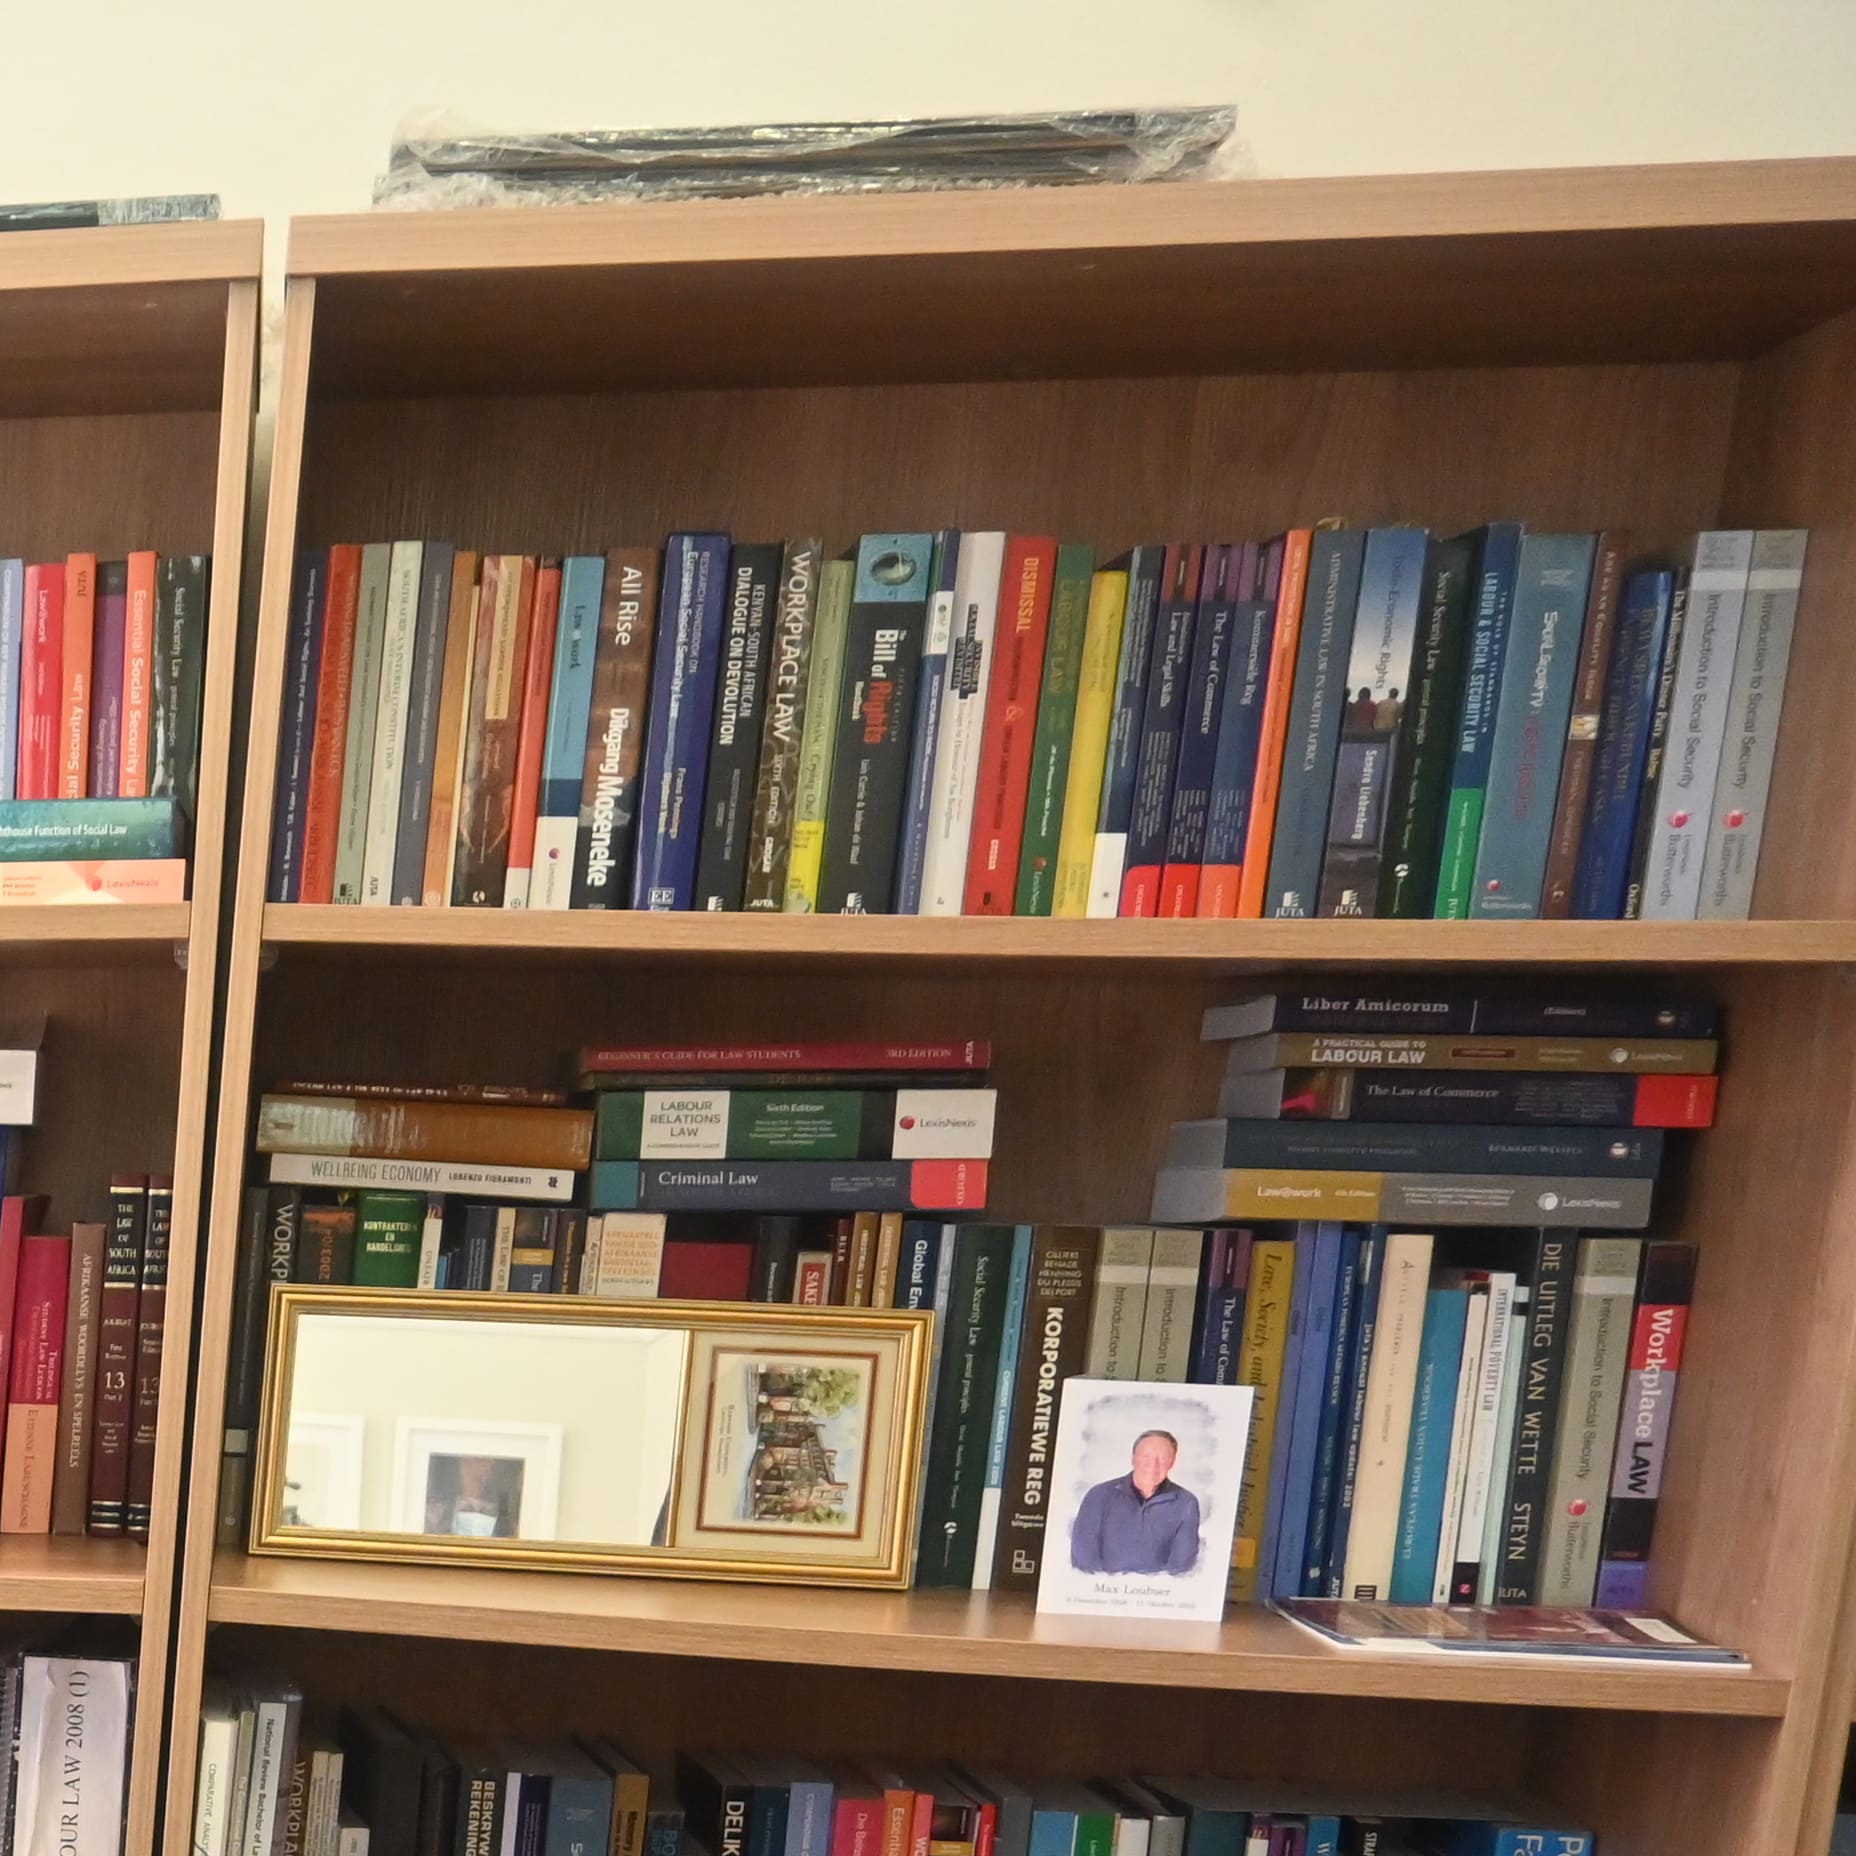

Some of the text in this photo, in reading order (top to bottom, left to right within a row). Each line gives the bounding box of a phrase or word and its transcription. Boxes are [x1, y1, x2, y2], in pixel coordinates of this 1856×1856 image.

[615, 566, 643, 646] All Rise
[776, 551, 811, 688] WORKPLACE
[1015, 557, 1039, 633] DISMISSAL
[126, 590, 146, 774] Essential Social Security
[719, 566, 754, 746] DIALOGUE ON DEVOLUTION
[739, 583, 766, 718] KENYAN-SOUTH AFRICAN
[861, 629, 899, 745] Bill of Rights
[1302, 551, 1342, 772] ADMINISTRATIVE LAW IN SOUTH AFRICA
[1461, 572, 1499, 754] LABOUR & SOCIAL SECURITY LAW
[67, 673, 85, 770] Security Law
[772, 692, 795, 743] LAW
[1677, 592, 1722, 789] Introduction to Social Security
[1733, 592, 1777, 790] Introduction to Social Security
[34, 824, 71, 837] Function
[73, 823, 81, 836] of
[82, 824, 110, 836] Social
[111, 824, 127, 836] Law
[586, 707, 630, 887] Dikgang Moseneke
[767, 786, 780, 825] EDITION
[1351, 749, 1378, 840] Sandra Liebenberg
[1658, 832, 1680, 907] Butterworths
[1713, 832, 1736, 907] Butterworths
[1301, 996, 1450, 1014] Liber Amicorum
[1311, 1048, 1426, 1065] LABOUR LAW
[648, 1112, 722, 1128] RELATIONS
[659, 1098, 715, 1115] LABOUR
[668, 1125, 700, 1140] LAW
[919, 1116, 978, 1131] LexisNexis
[310, 1159, 442, 1186] WELLBEING ECONOMY
[657, 1168, 759, 1188] Criminal Law
[1023, 1306, 1065, 1506] KORPORATIEWE REG
[1507, 1243, 1562, 1561] DIE UITLEG VAN WETTE STEYN
[1627, 1308, 1675, 1494] Workplace LAW
[70, 1670, 90, 1698] (1)
[65, 1703, 86, 1747] 2008
[258, 1718, 276, 1757] National
[63, 1745, 82, 1808] LAW
[256, 1758, 272, 1791] Review
[250, 1793, 267, 1832] Bachelor
[250, 1833, 263, 1842] of
